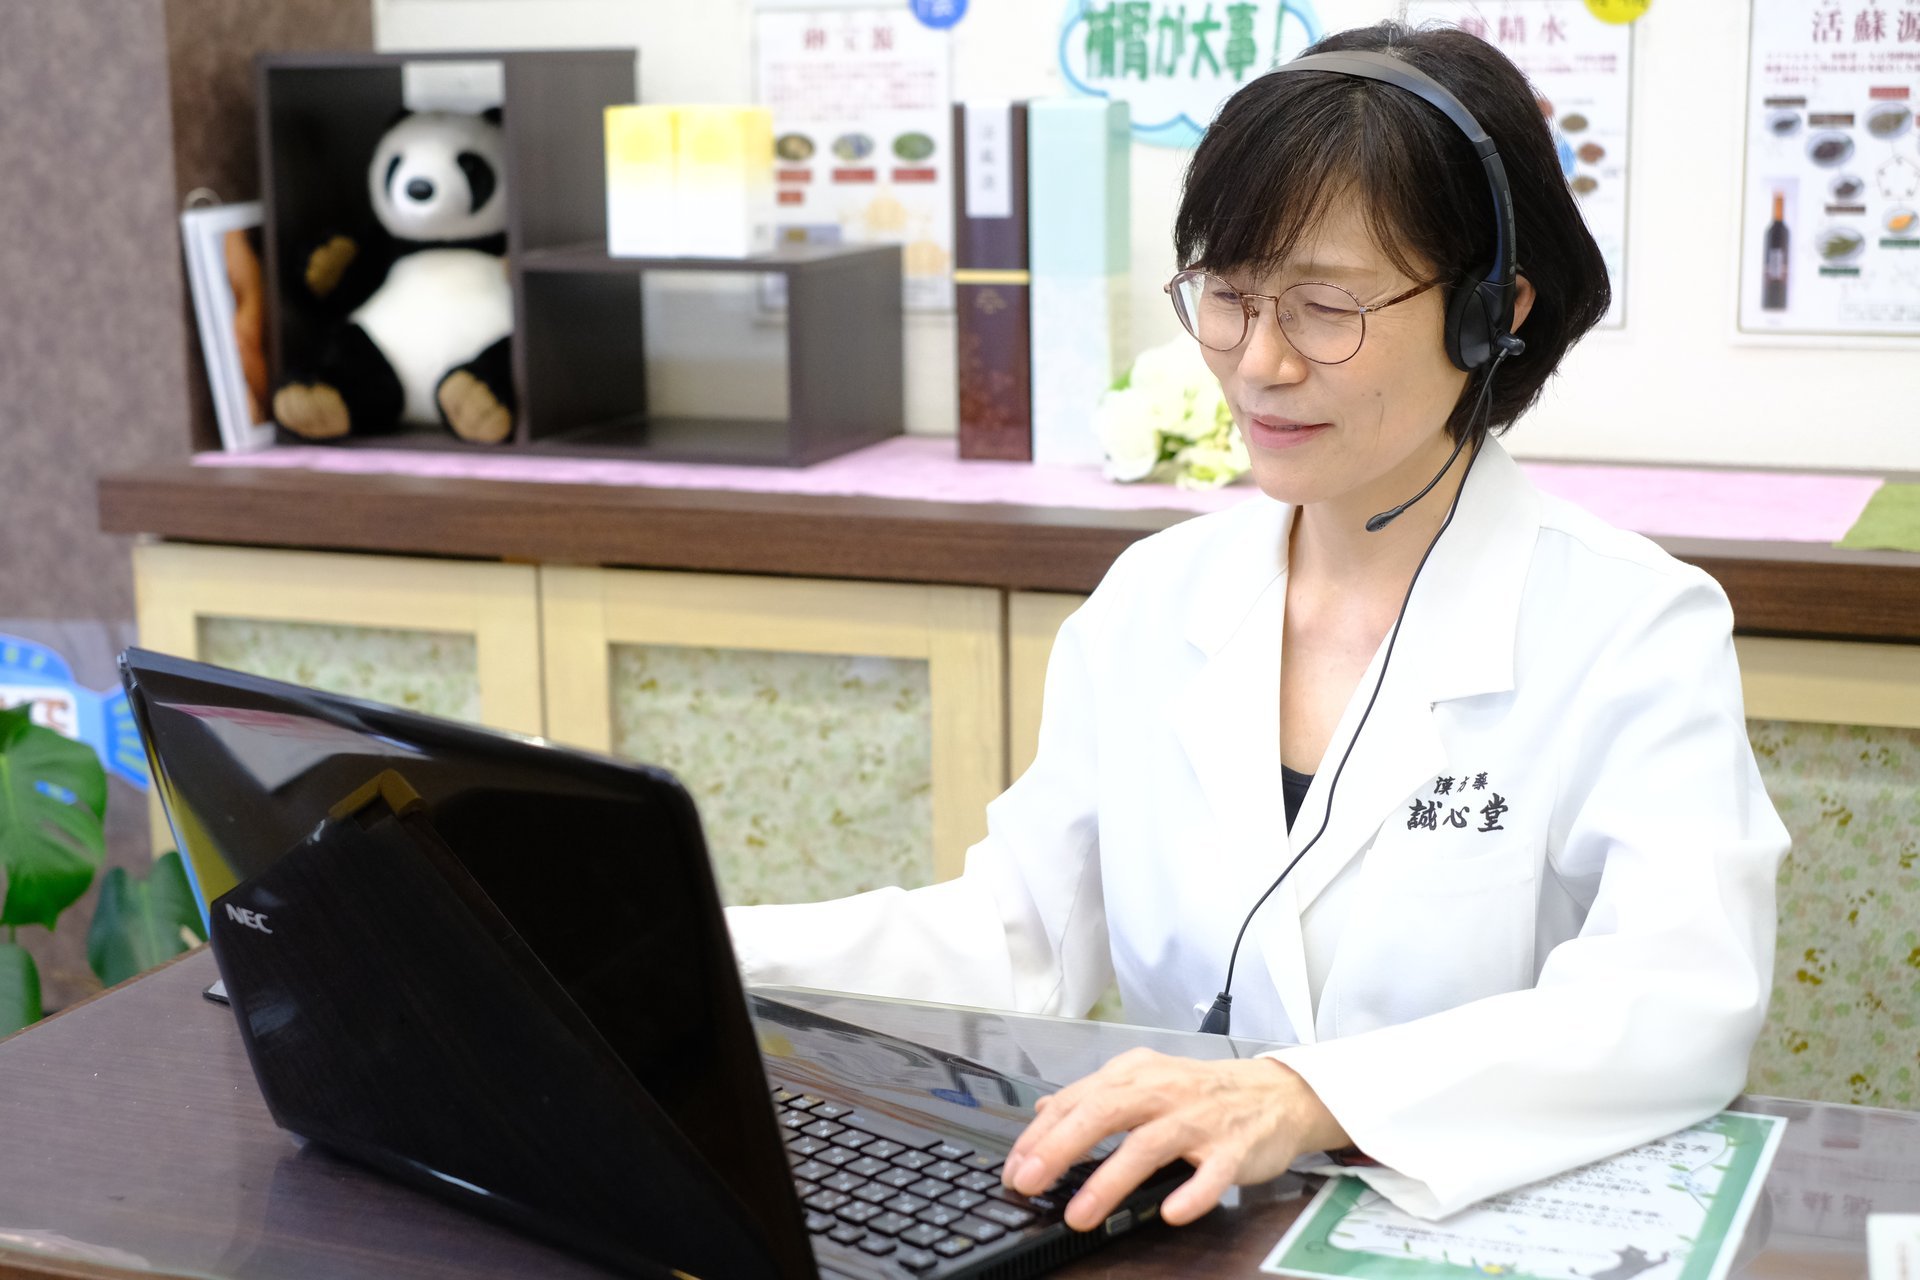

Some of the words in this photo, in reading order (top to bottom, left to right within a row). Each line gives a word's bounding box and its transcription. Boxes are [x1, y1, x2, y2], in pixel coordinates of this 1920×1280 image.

[1407, 793, 1508, 832] 誠心堂
[225, 902, 273, 934] NEC
